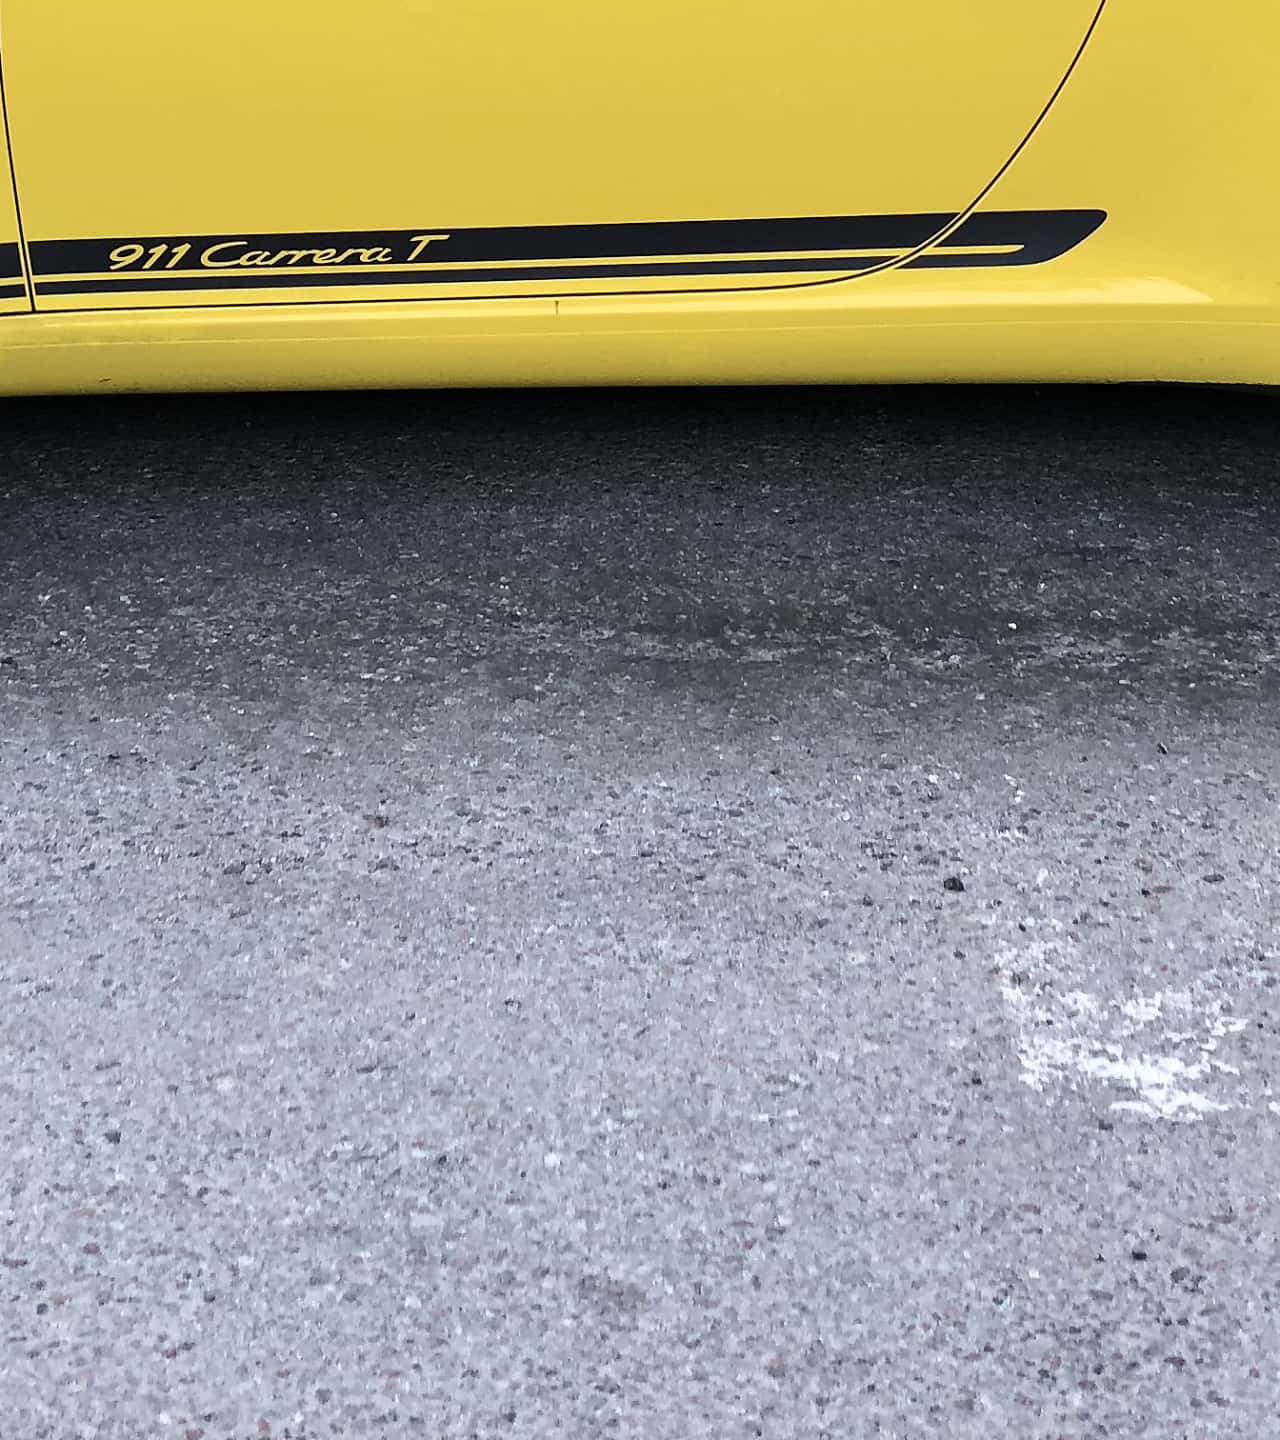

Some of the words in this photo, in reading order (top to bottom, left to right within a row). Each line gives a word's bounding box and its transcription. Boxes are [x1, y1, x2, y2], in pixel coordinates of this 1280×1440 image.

[110, 242, 192, 270] 911
[200, 241, 393, 268] Carrera
[407, 234, 451, 262] T
